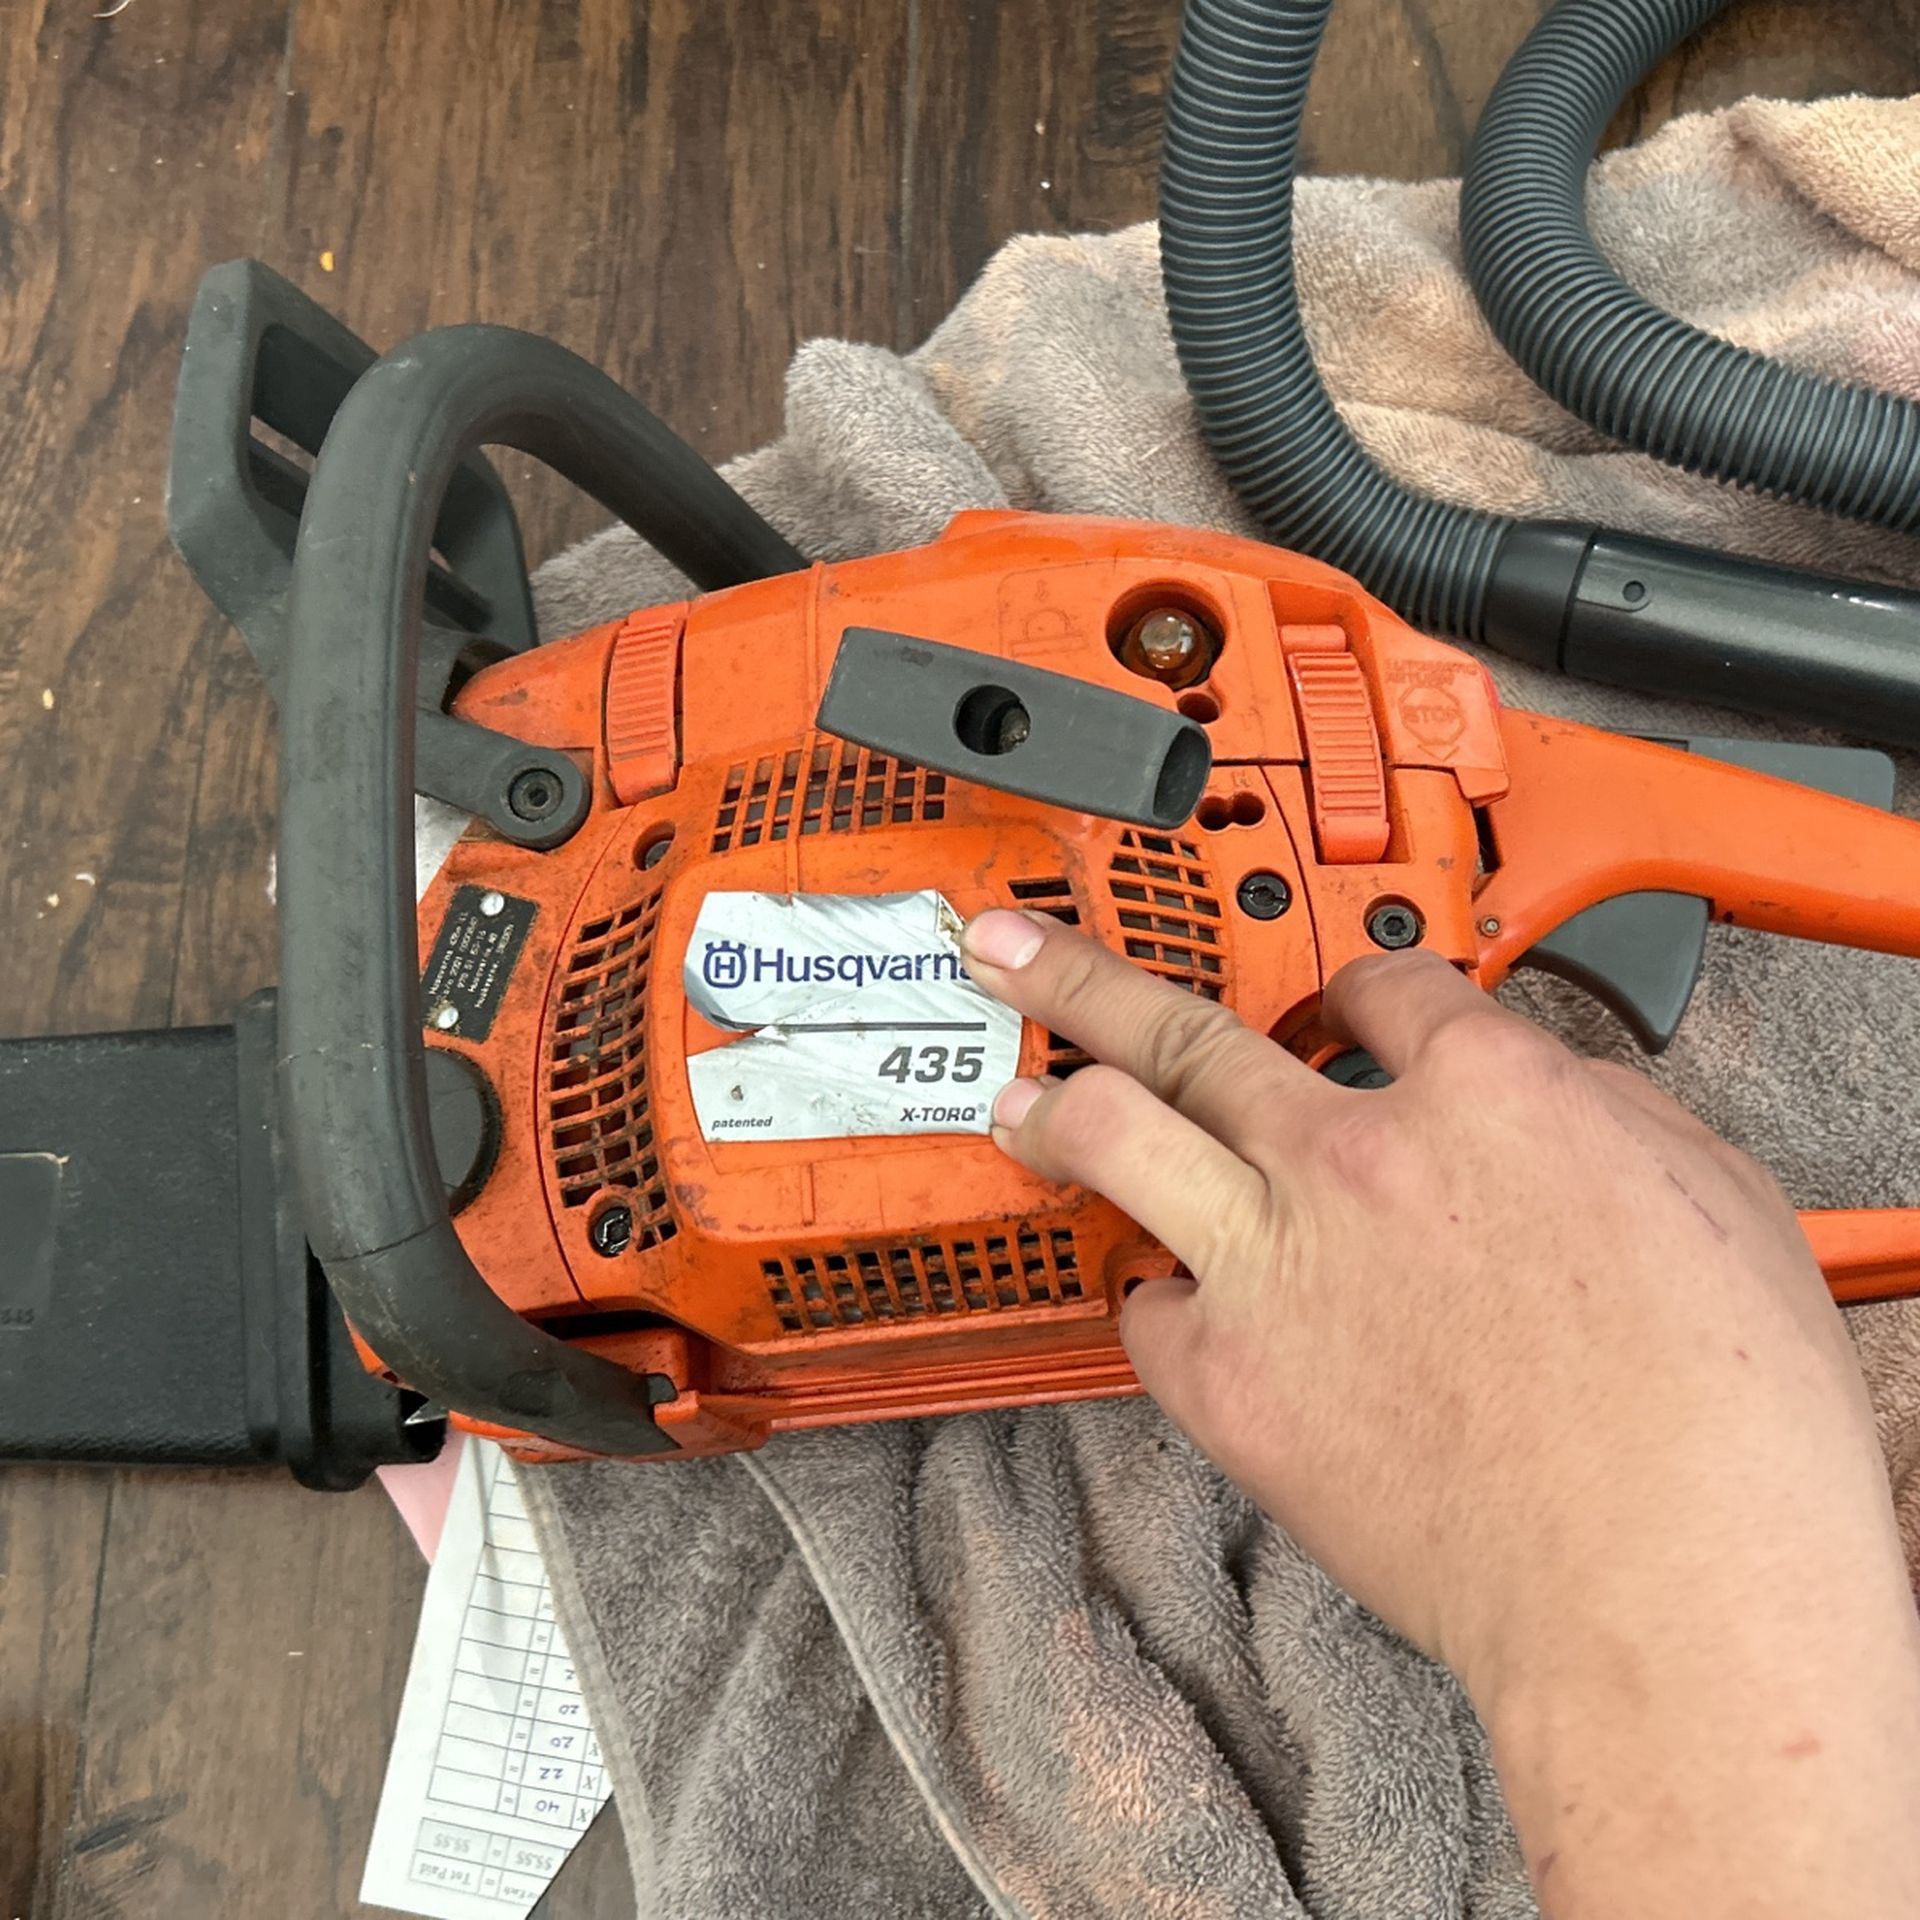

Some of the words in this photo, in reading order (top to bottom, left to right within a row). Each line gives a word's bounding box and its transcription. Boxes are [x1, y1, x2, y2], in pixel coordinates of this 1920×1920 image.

[878, 1046, 986, 1084] 435
[711, 1116, 773, 1131] patented
[558, 1703, 580, 1715] 20
[550, 1735, 575, 1749] 20
[538, 1767, 564, 1780] 22
[535, 1800, 560, 1813] 40
[419, 1862, 448, 1880] Paid
[451, 1871, 471, 1886] Tot
